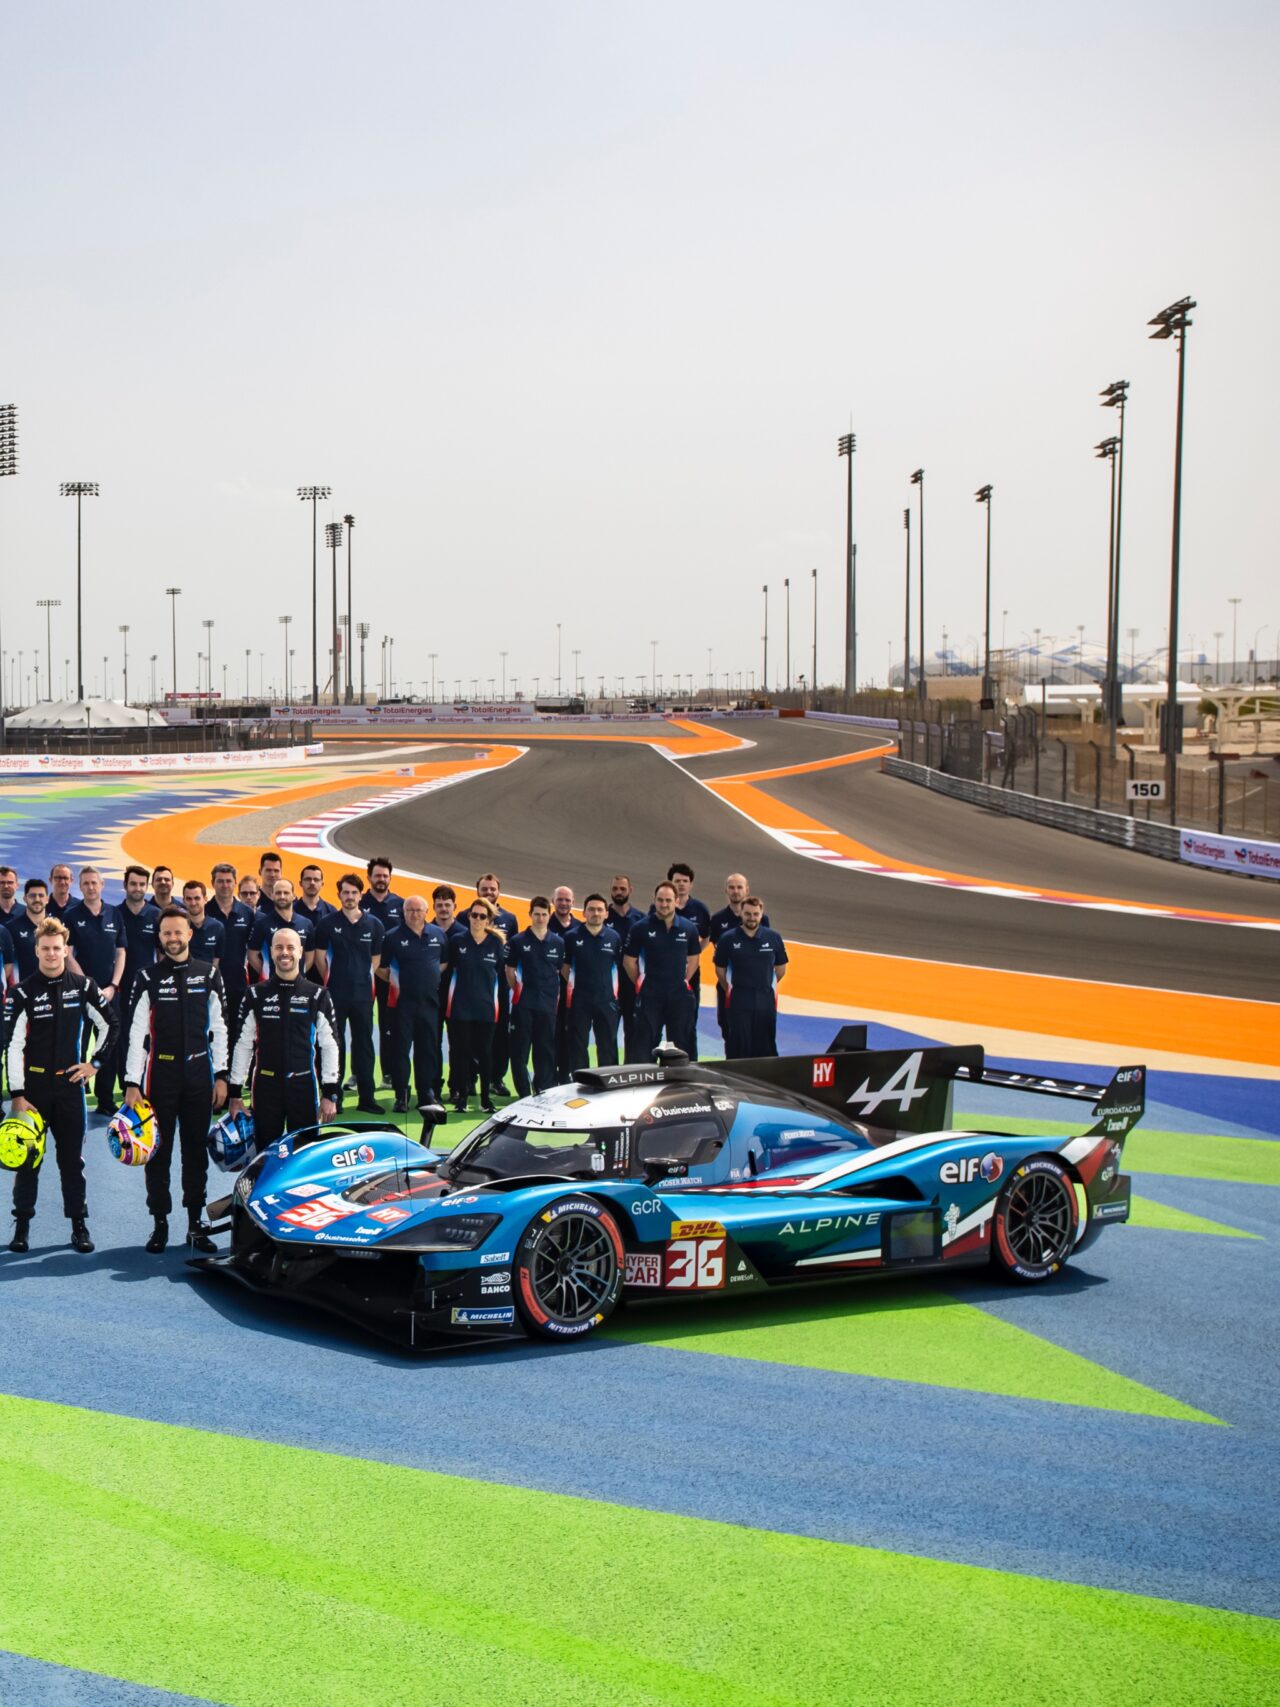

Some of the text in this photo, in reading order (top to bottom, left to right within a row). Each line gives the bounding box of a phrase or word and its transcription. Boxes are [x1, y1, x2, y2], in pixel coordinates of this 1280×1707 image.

[1131, 783, 1161, 797] 150
[1248, 851, 1280, 868] TotalEne
[607, 1072, 665, 1084] ALPINE
[813, 1062, 833, 1083] HY
[1116, 1070, 1133, 1083] elf
[660, 1103, 712, 1117] businessolver
[331, 1148, 359, 1168] elf
[939, 1157, 980, 1184] elf
[1030, 1161, 1062, 1175] MICHELIN
[441, 1197, 465, 1207] elf
[558, 1202, 599, 1214] MICHELIN
[631, 1198, 662, 1216] GCR
[280, 1202, 352, 1227] 36
[371, 1208, 406, 1221] HY
[678, 1222, 719, 1237] DHL
[778, 1212, 882, 1235] ALPINE
[324, 1233, 370, 1243] businessolver
[483, 1253, 507, 1263] Sabelt
[625, 1255, 658, 1267] HYPER
[666, 1239, 725, 1287] 36
[624, 1267, 658, 1283] CAR
[481, 1285, 511, 1295] BAHCO
[469, 1312, 513, 1320] MICHELIN
[548, 1321, 590, 1334] MICHELIN
